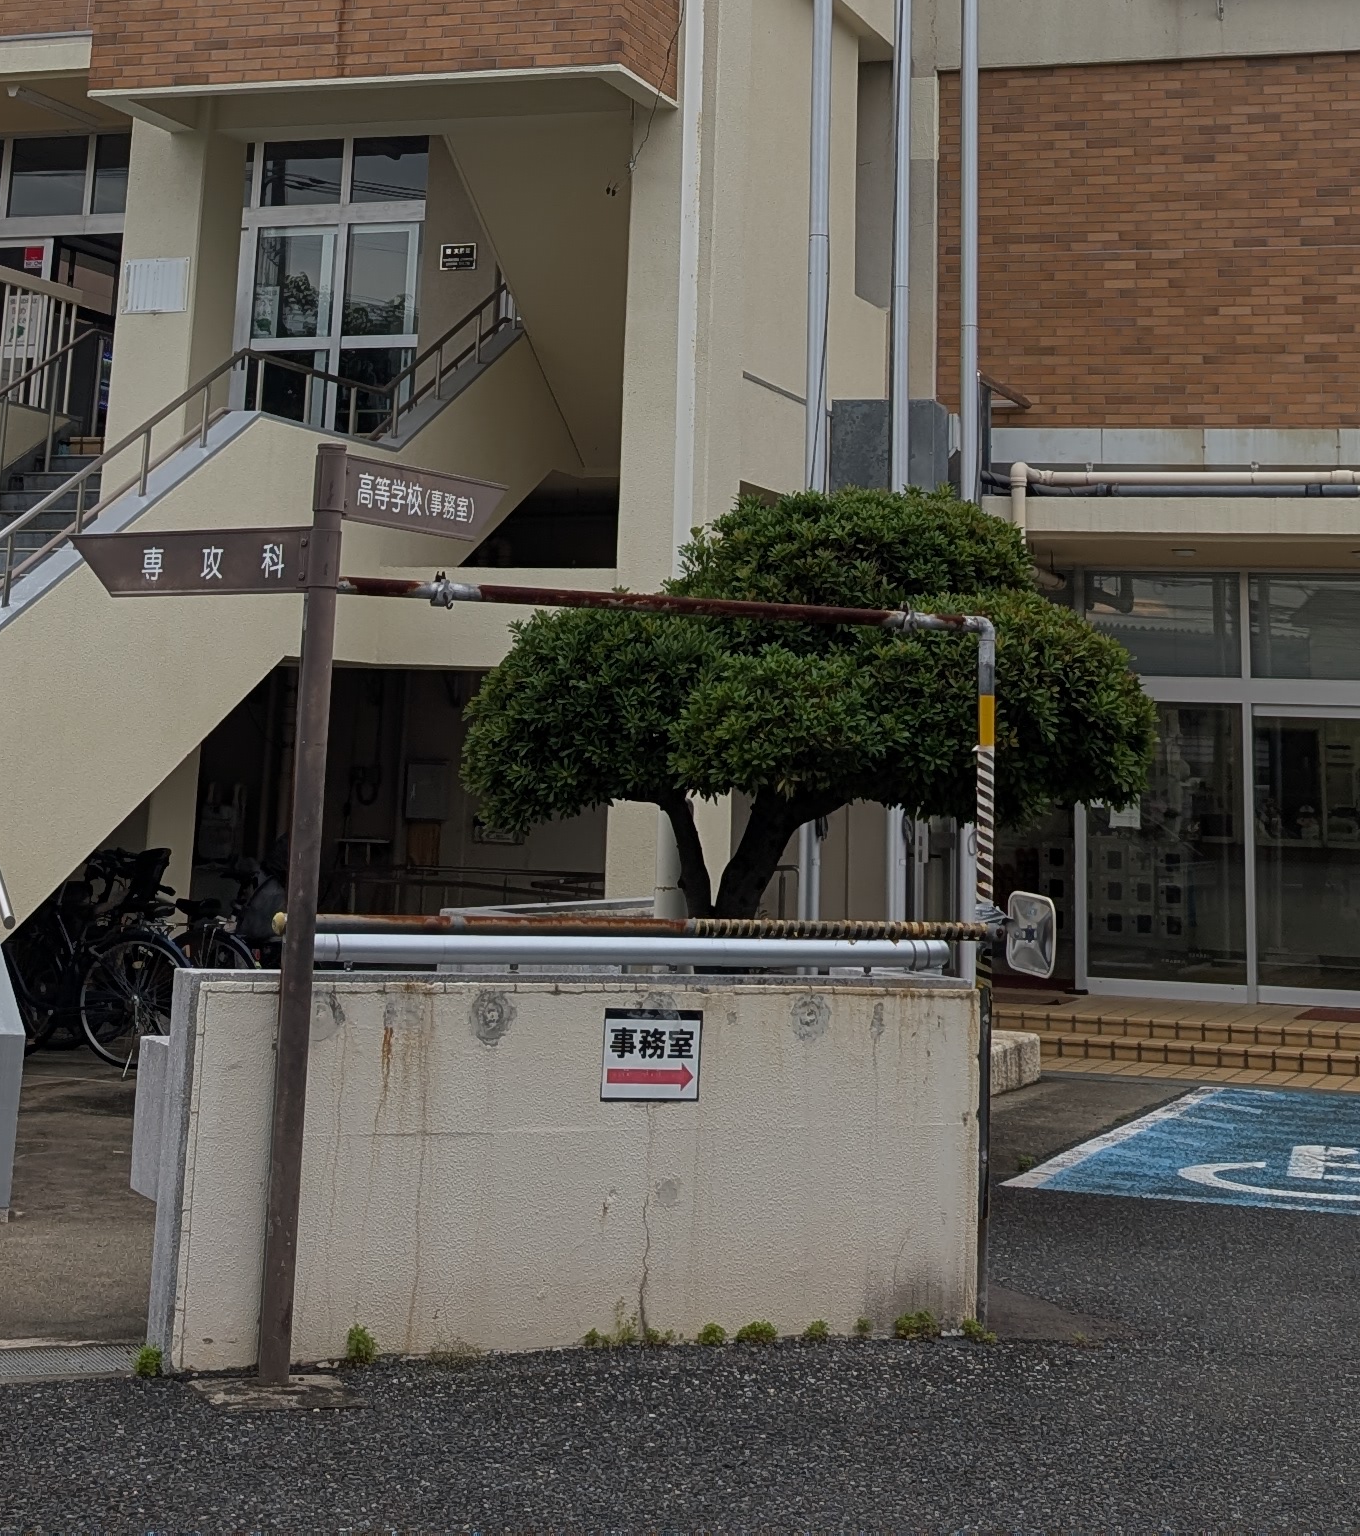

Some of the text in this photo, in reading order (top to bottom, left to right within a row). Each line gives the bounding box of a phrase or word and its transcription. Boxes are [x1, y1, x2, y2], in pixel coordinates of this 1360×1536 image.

[356, 472, 475, 524] 高等学校(事務室)
[141, 543, 285, 581] 専攻科
[609, 1027, 694, 1059] 事務室
